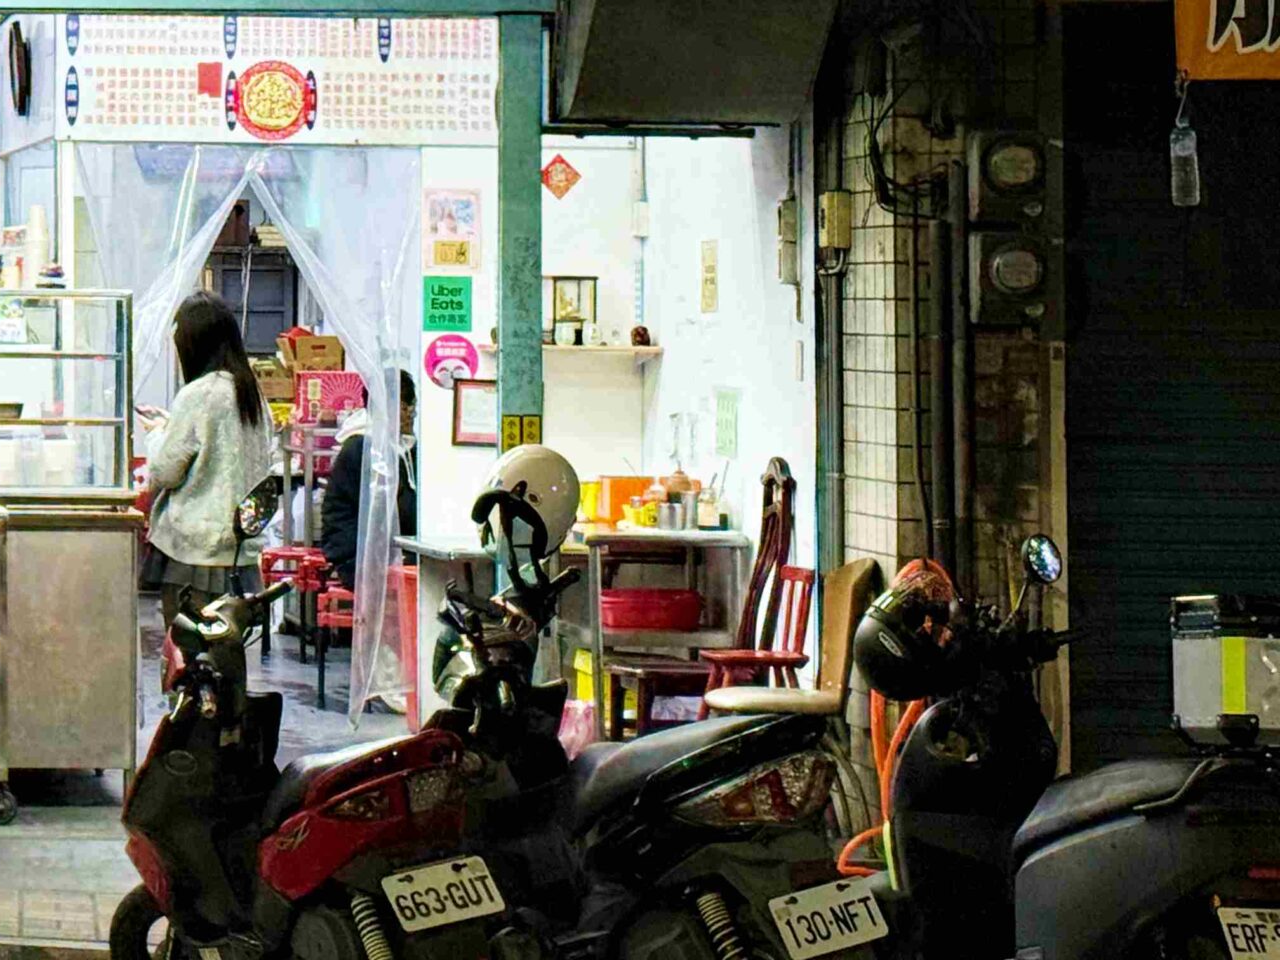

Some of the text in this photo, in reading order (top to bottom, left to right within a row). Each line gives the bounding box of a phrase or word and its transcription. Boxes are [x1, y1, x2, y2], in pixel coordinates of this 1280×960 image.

[431, 284, 464, 297] Uber
[431, 298, 464, 311] Eats
[395, 875, 495, 921] 663-GUT
[785, 896, 878, 949] 130-NFT
